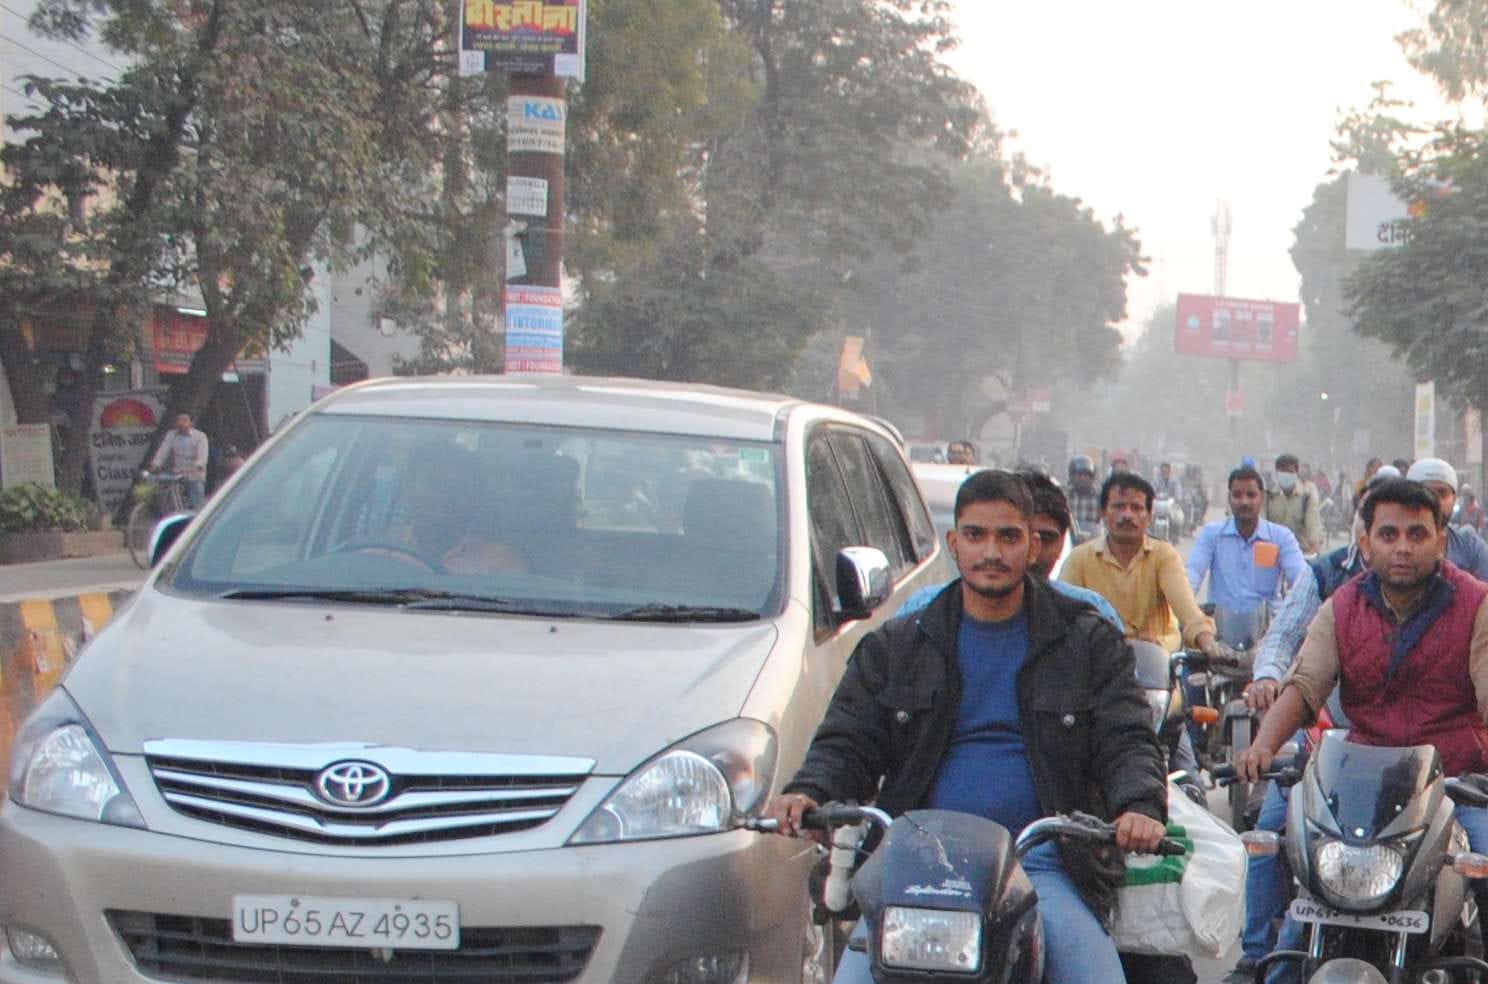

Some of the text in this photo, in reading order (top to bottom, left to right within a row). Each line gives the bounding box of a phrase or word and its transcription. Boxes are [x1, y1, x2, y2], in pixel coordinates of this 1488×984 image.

[240, 908, 453, 940] UP65 AZ 4935
